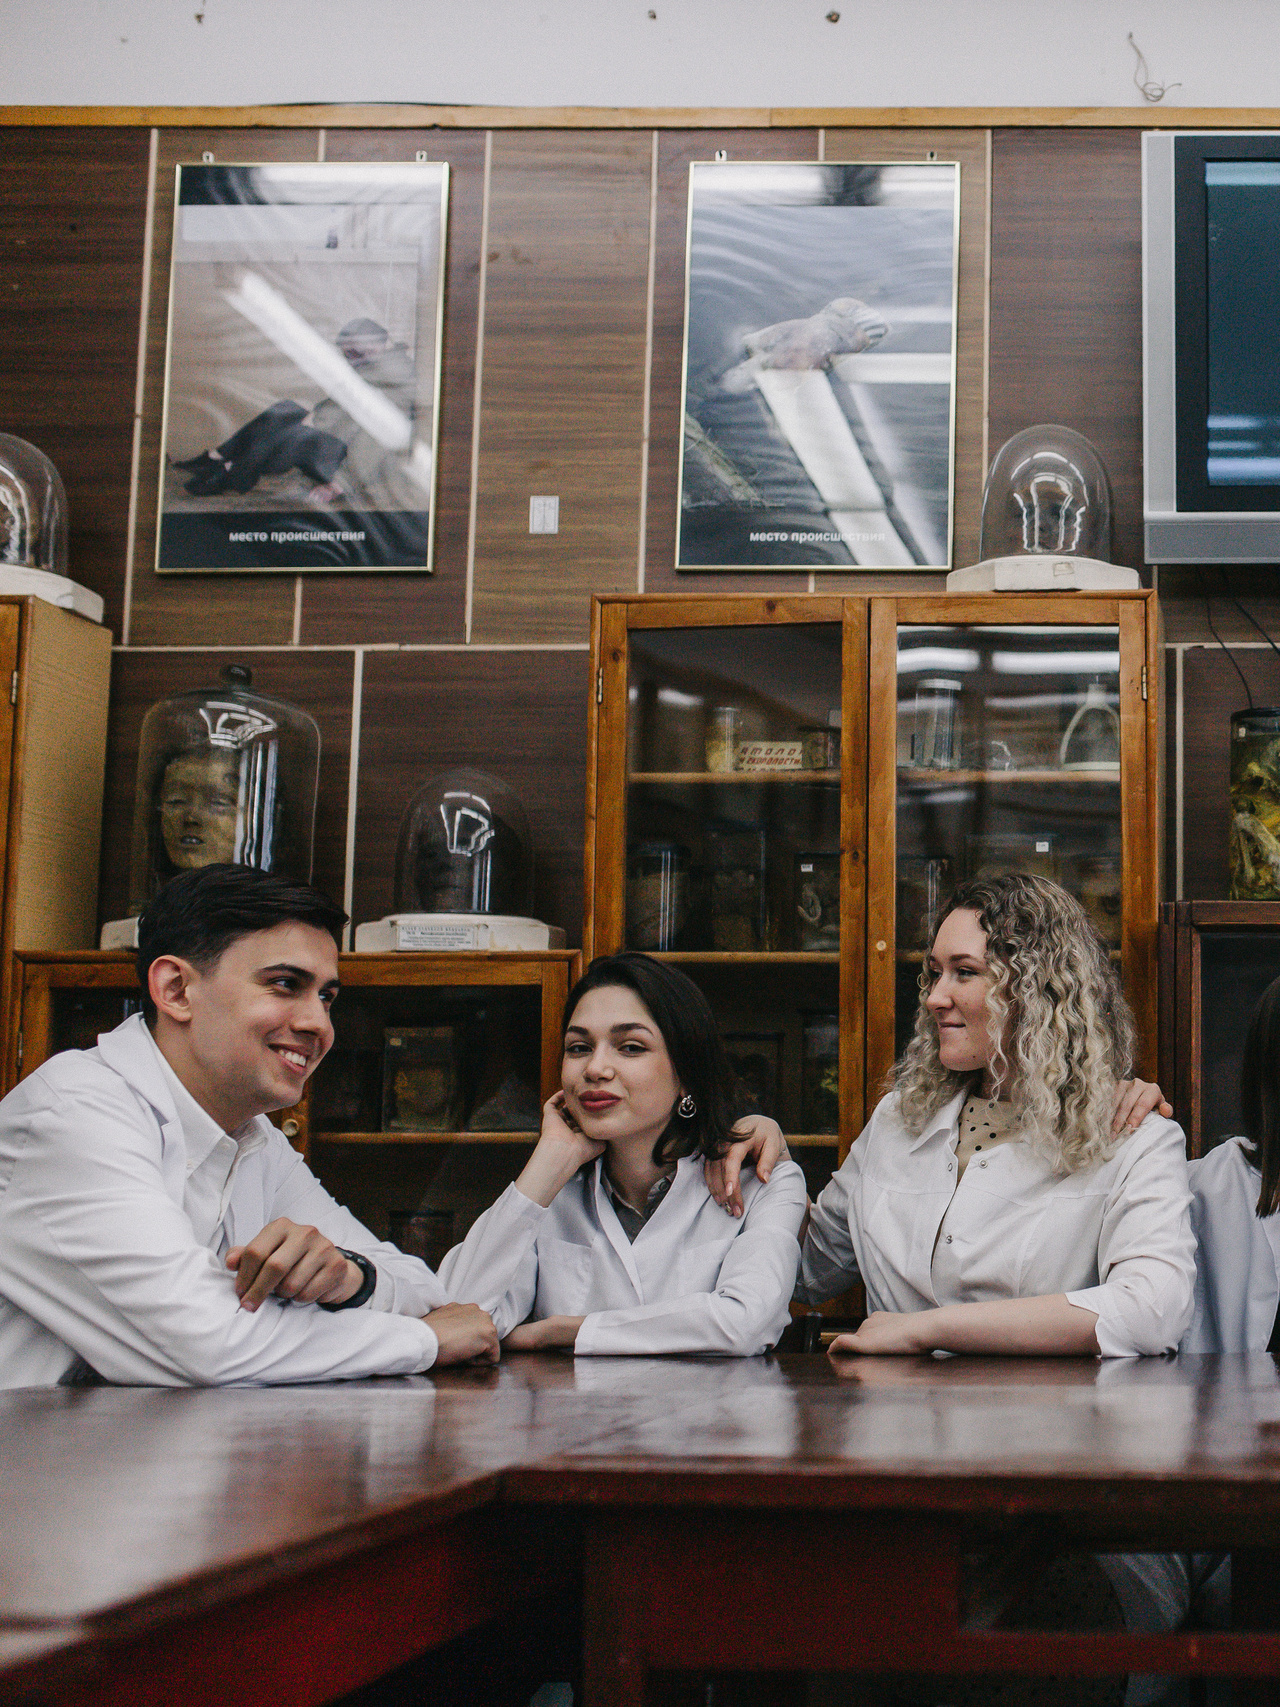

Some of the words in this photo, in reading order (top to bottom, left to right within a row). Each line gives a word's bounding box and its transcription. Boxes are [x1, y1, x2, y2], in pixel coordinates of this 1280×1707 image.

[229, 532, 268, 542] место
[270, 531, 366, 544] происшествия
[749, 532, 789, 542] место
